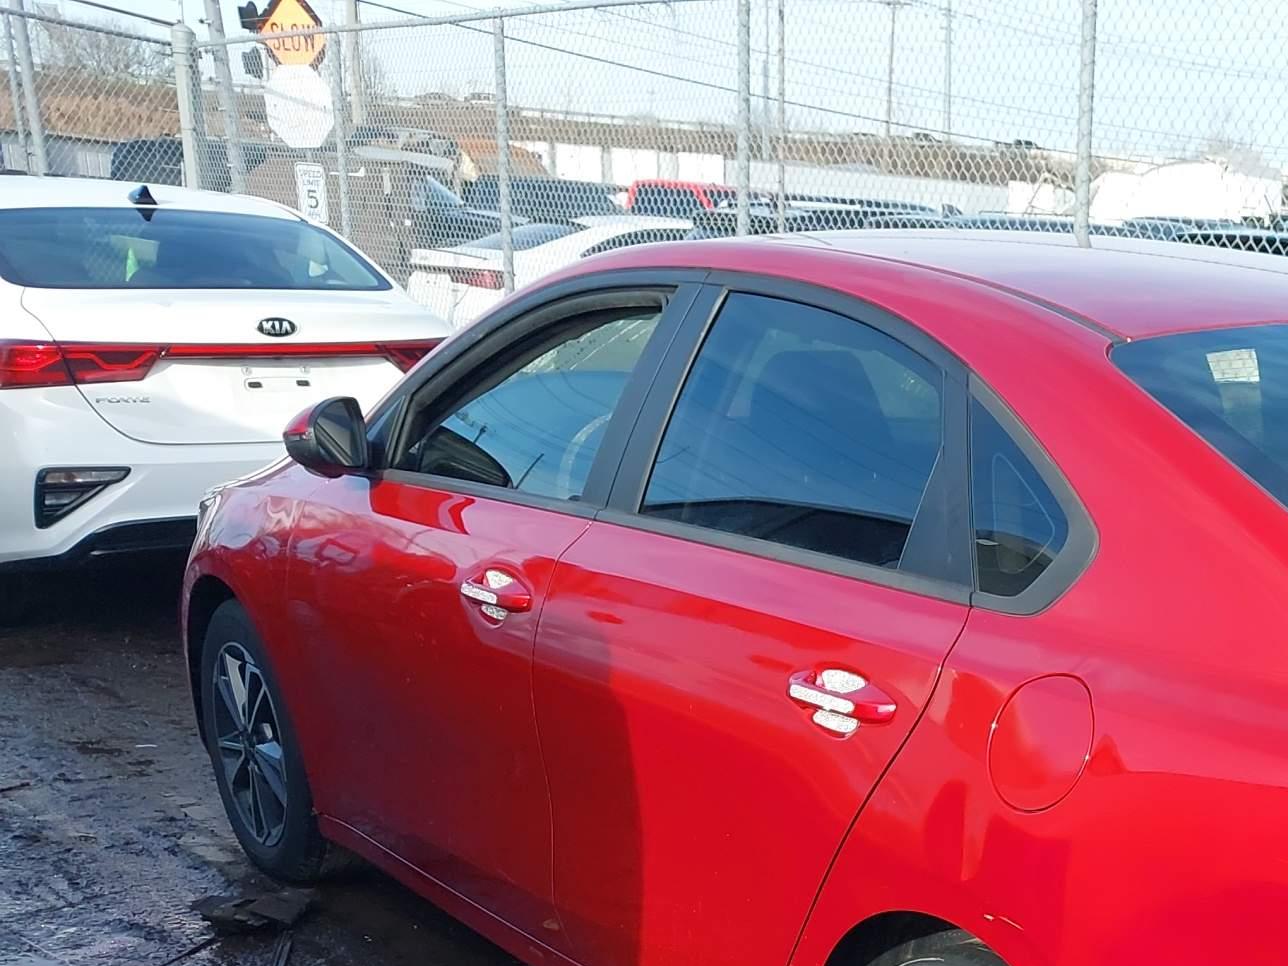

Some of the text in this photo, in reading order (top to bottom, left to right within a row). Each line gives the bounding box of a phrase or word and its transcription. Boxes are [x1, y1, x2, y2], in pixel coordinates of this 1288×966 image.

[270, 22, 316, 52] SLOW
[307, 189, 319, 209] 5
[262, 320, 293, 335] KIA
